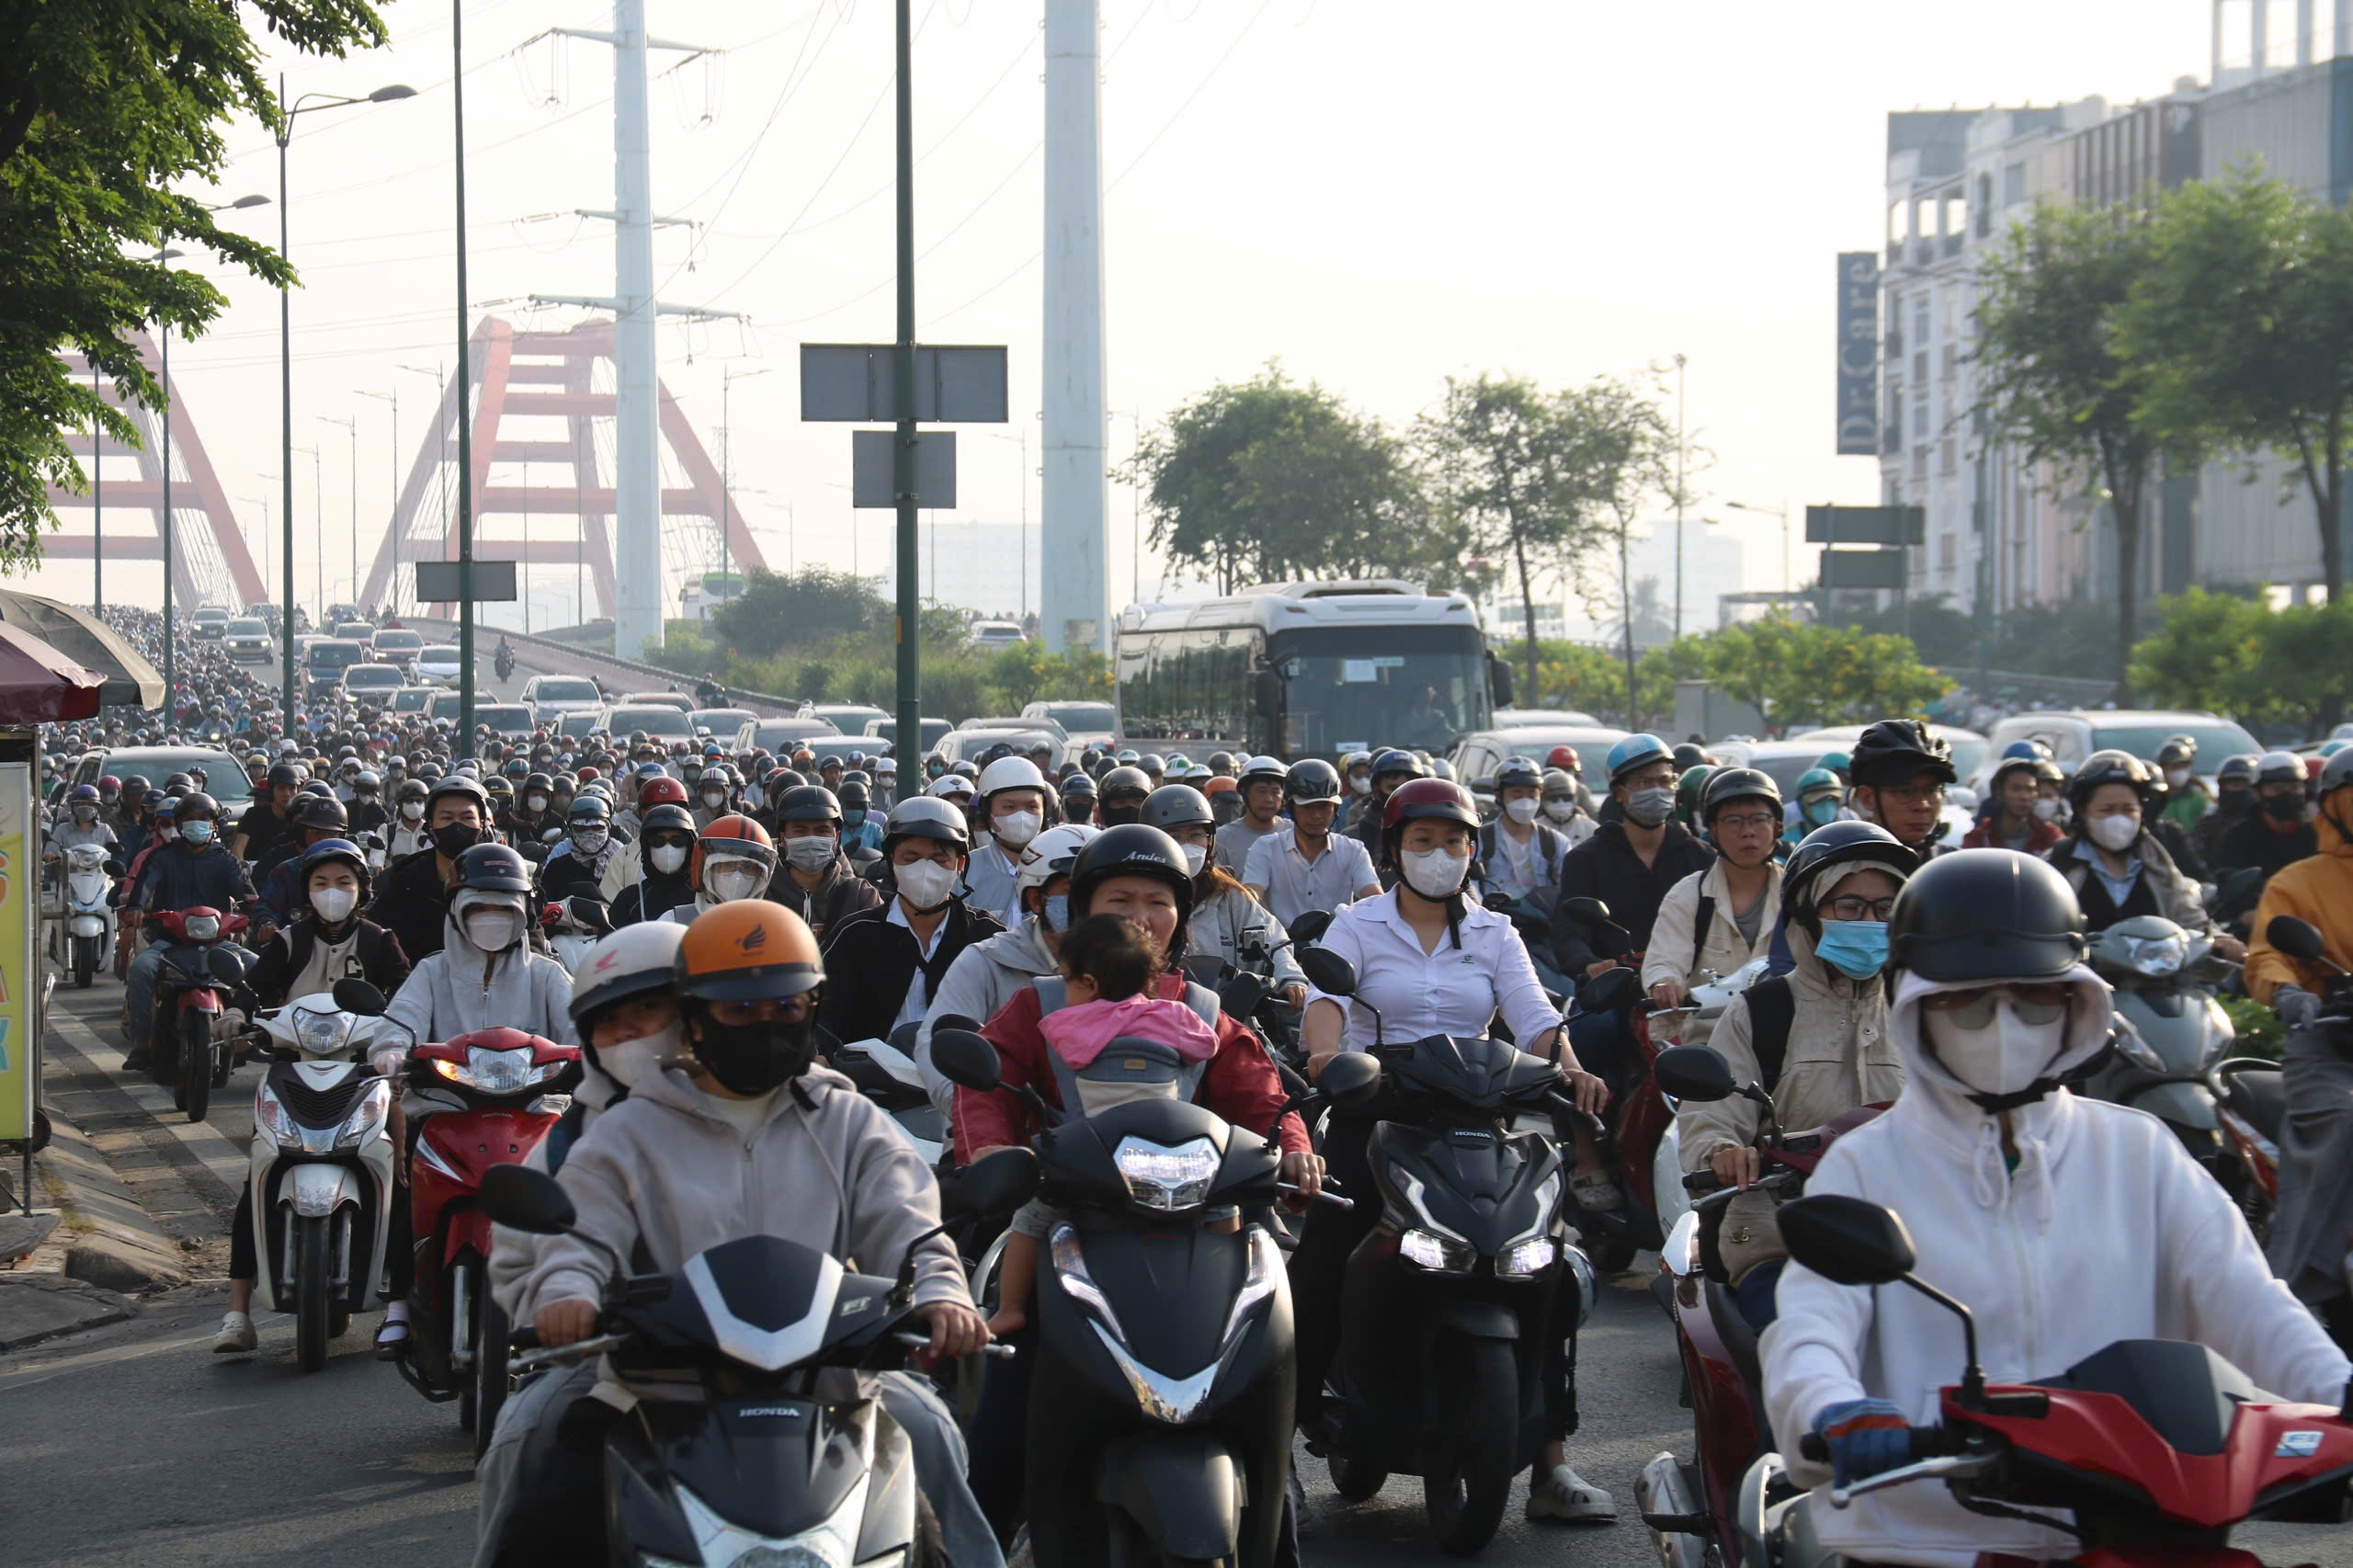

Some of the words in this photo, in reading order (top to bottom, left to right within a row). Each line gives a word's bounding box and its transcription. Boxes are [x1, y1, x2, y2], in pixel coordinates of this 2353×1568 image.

[1121, 850, 1166, 863] Andes
[1455, 1131, 1491, 1139] HONDA
[738, 1407, 800, 1417] HONDA
